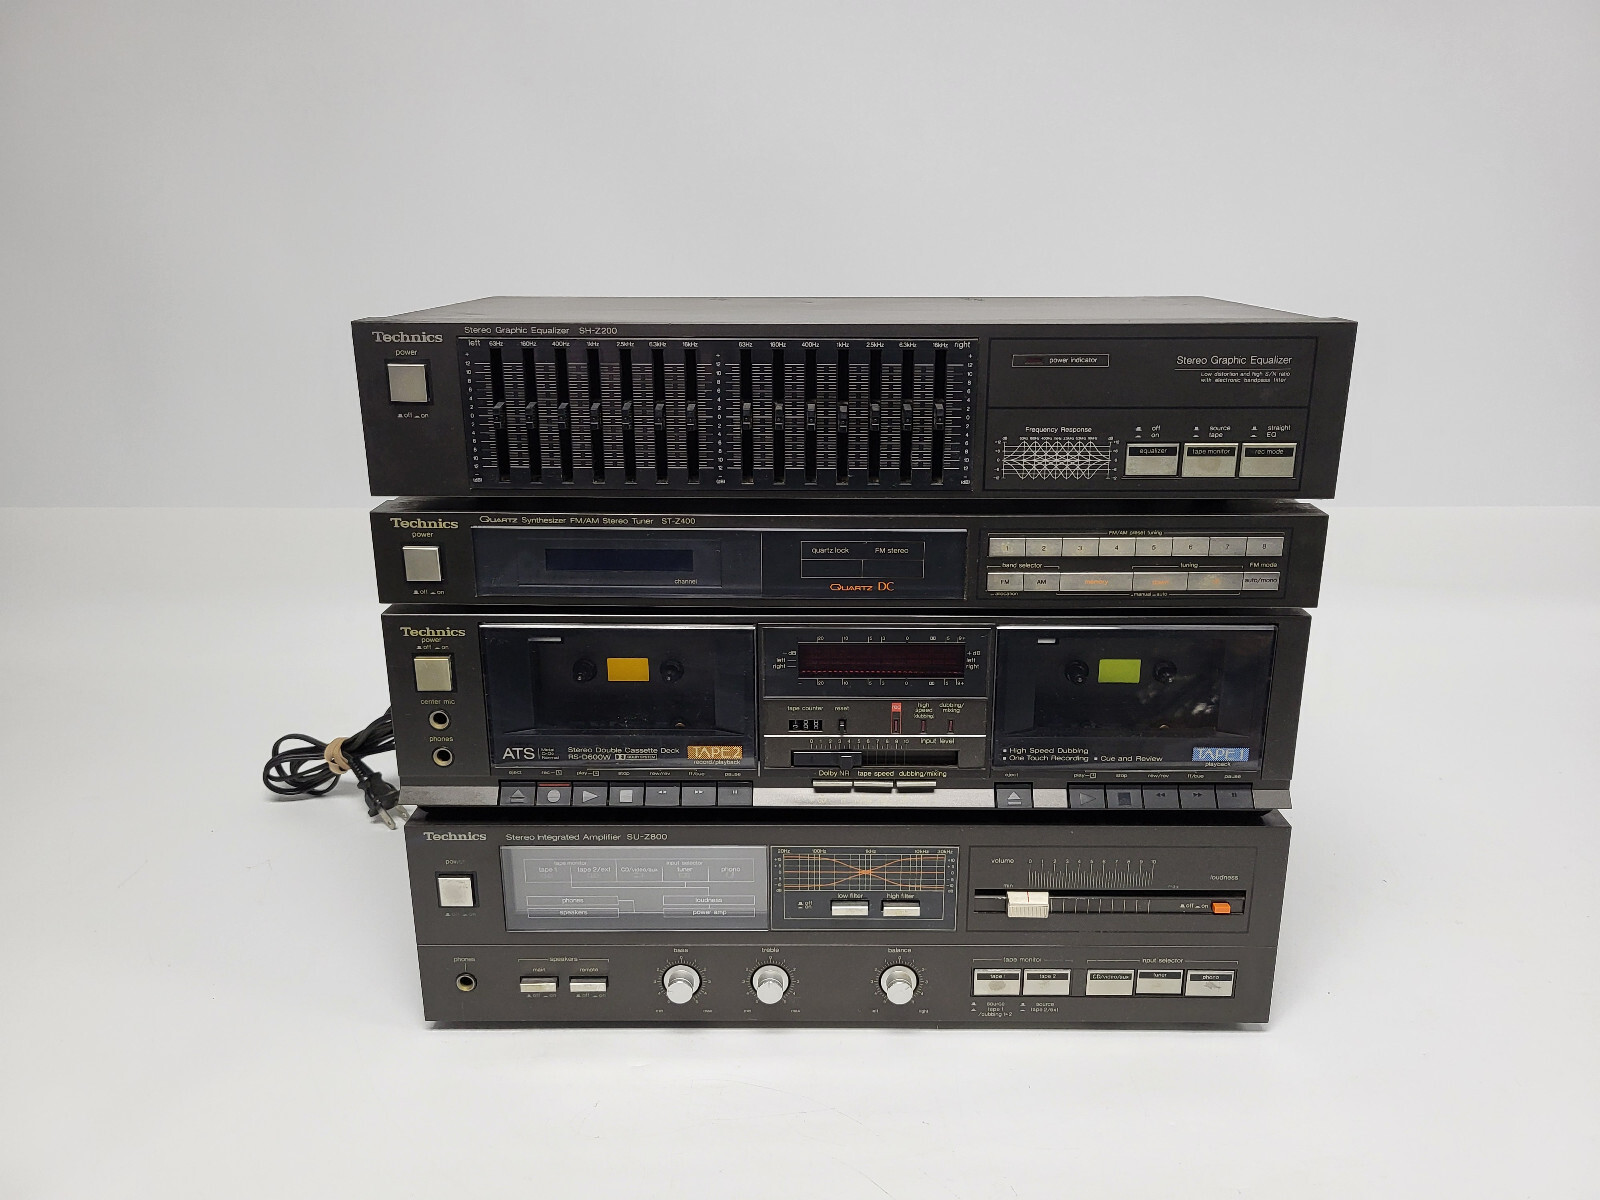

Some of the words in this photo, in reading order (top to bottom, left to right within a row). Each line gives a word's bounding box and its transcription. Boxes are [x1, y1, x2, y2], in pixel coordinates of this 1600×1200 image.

[372, 332, 443, 343] Technics
[954, 341, 970, 349] right
[395, 349, 417, 357] power
[1177, 356, 1208, 365] Stereo
[1211, 356, 1246, 366] Graphic
[1251, 356, 1292, 365] Equalizer
[1140, 447, 1167, 455] equalizer
[390, 518, 459, 529] Technics
[521, 517, 566, 525] Synthesizer
[878, 582, 894, 591] DC
[400, 627, 465, 637] Technics
[502, 748, 535, 760] ATS
[693, 747, 730, 758] TAPE
[733, 747, 740, 757] 2
[1198, 748, 1236, 760] TAPE
[424, 832, 487, 841] Technics
